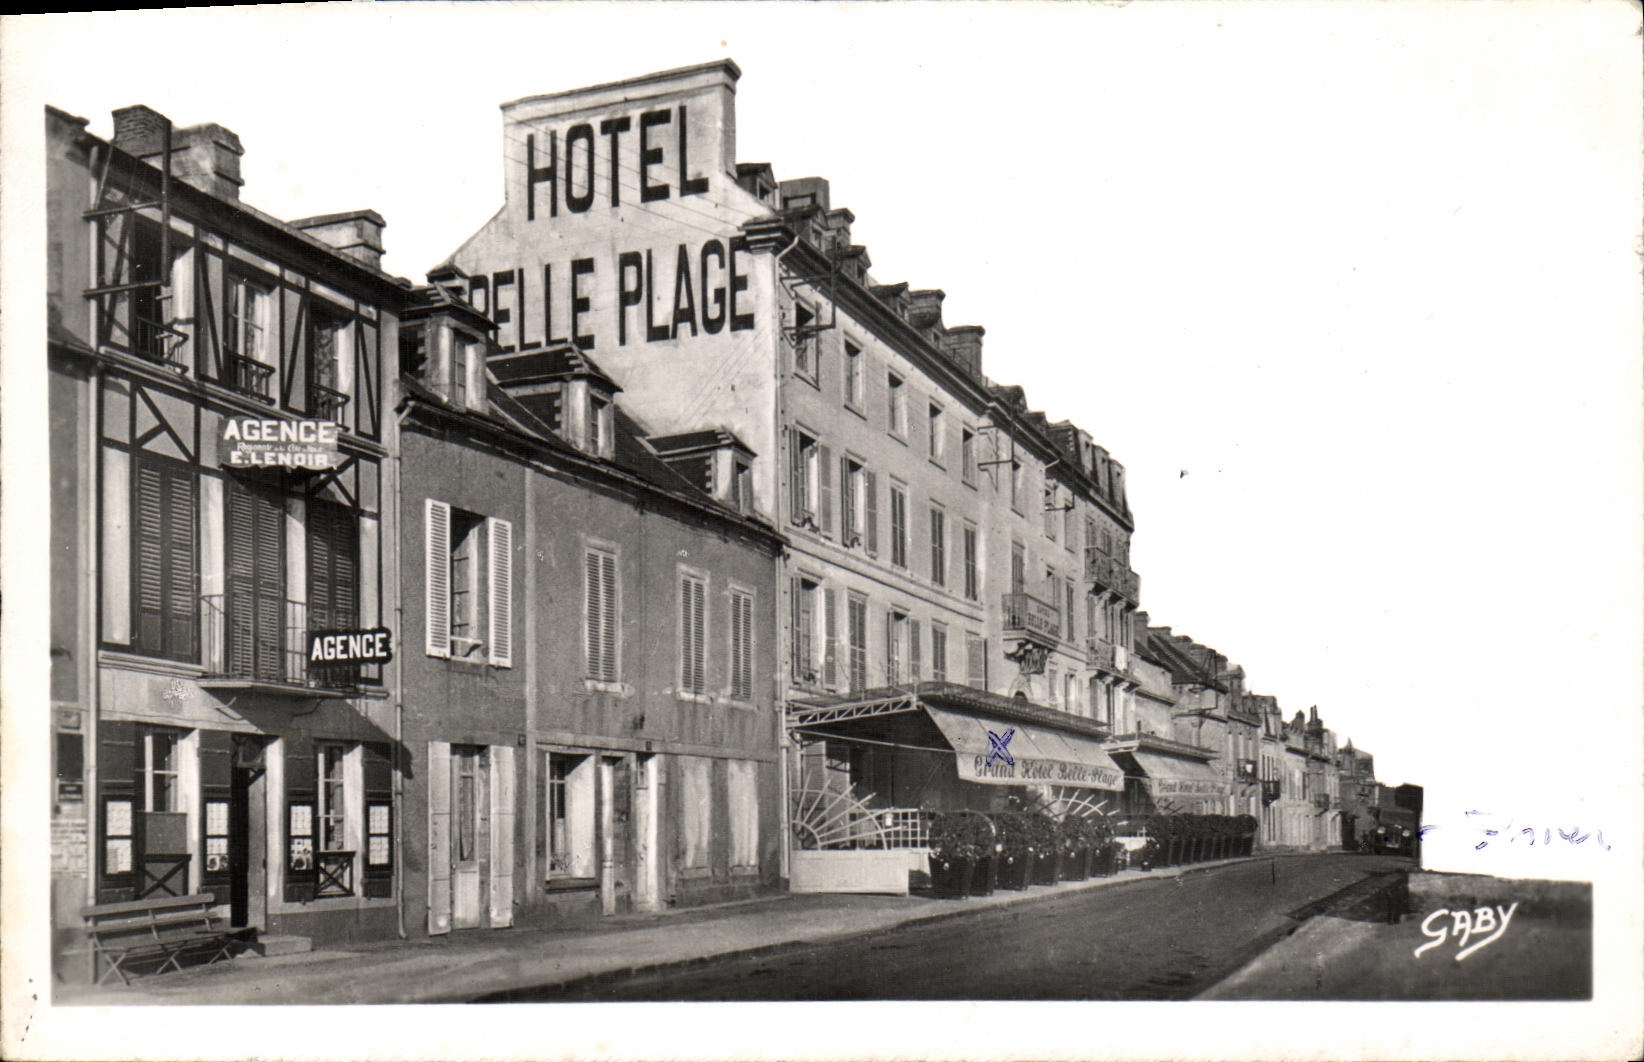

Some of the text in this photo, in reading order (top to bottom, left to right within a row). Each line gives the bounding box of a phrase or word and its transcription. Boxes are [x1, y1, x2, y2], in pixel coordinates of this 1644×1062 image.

[527, 105, 709, 221] HOTEL
[618, 235, 755, 347] PLAGE
[223, 418, 337, 444] AGENCE
[311, 632, 388, 661] AGENCE
[974, 755, 1016, 778] Grand
